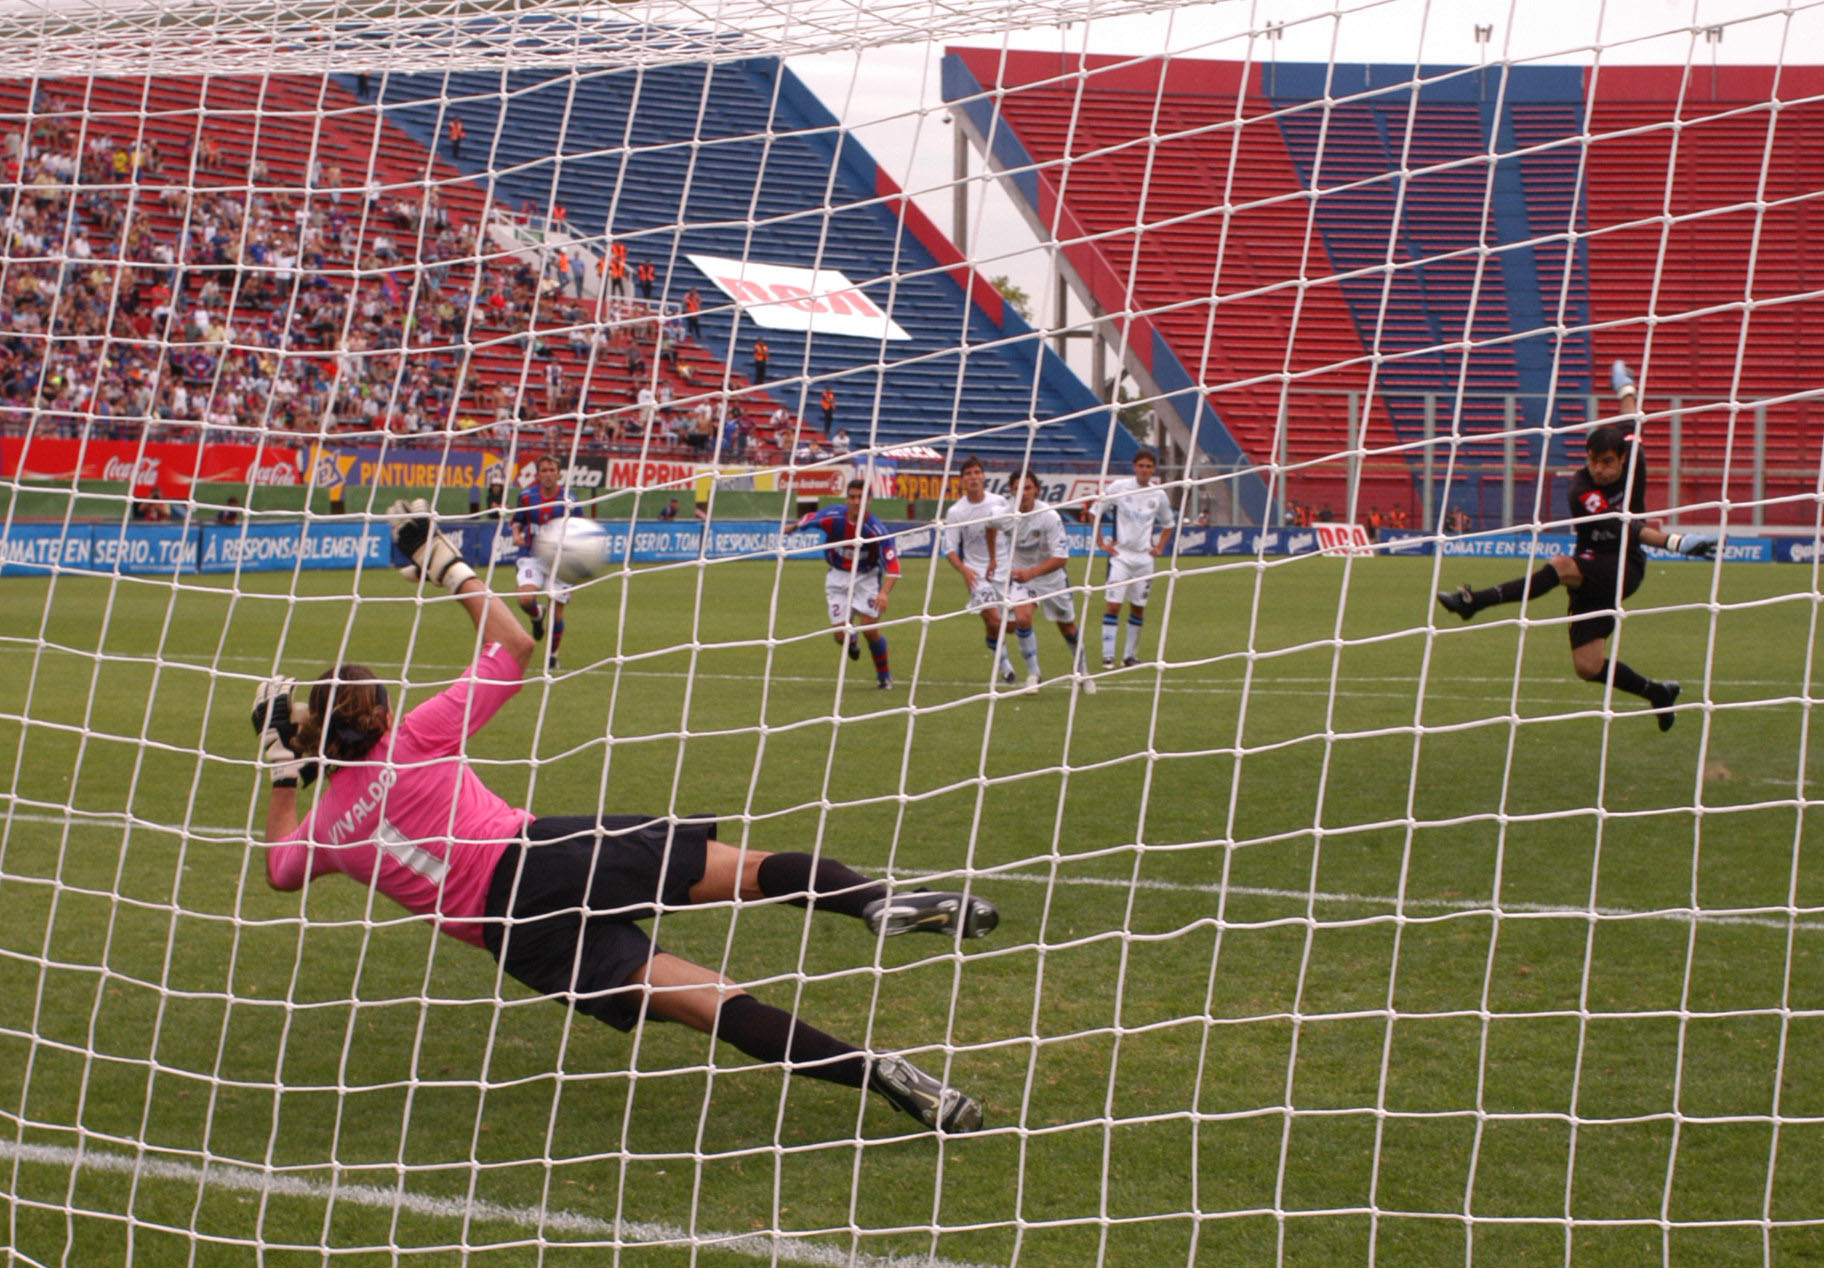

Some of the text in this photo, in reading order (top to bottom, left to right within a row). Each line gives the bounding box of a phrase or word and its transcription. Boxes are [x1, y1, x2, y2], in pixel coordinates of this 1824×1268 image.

[64, 539, 92, 563] EN
[221, 536, 382, 562] RESPONSABLEMENTE
[1495, 540, 1515, 555] EN
